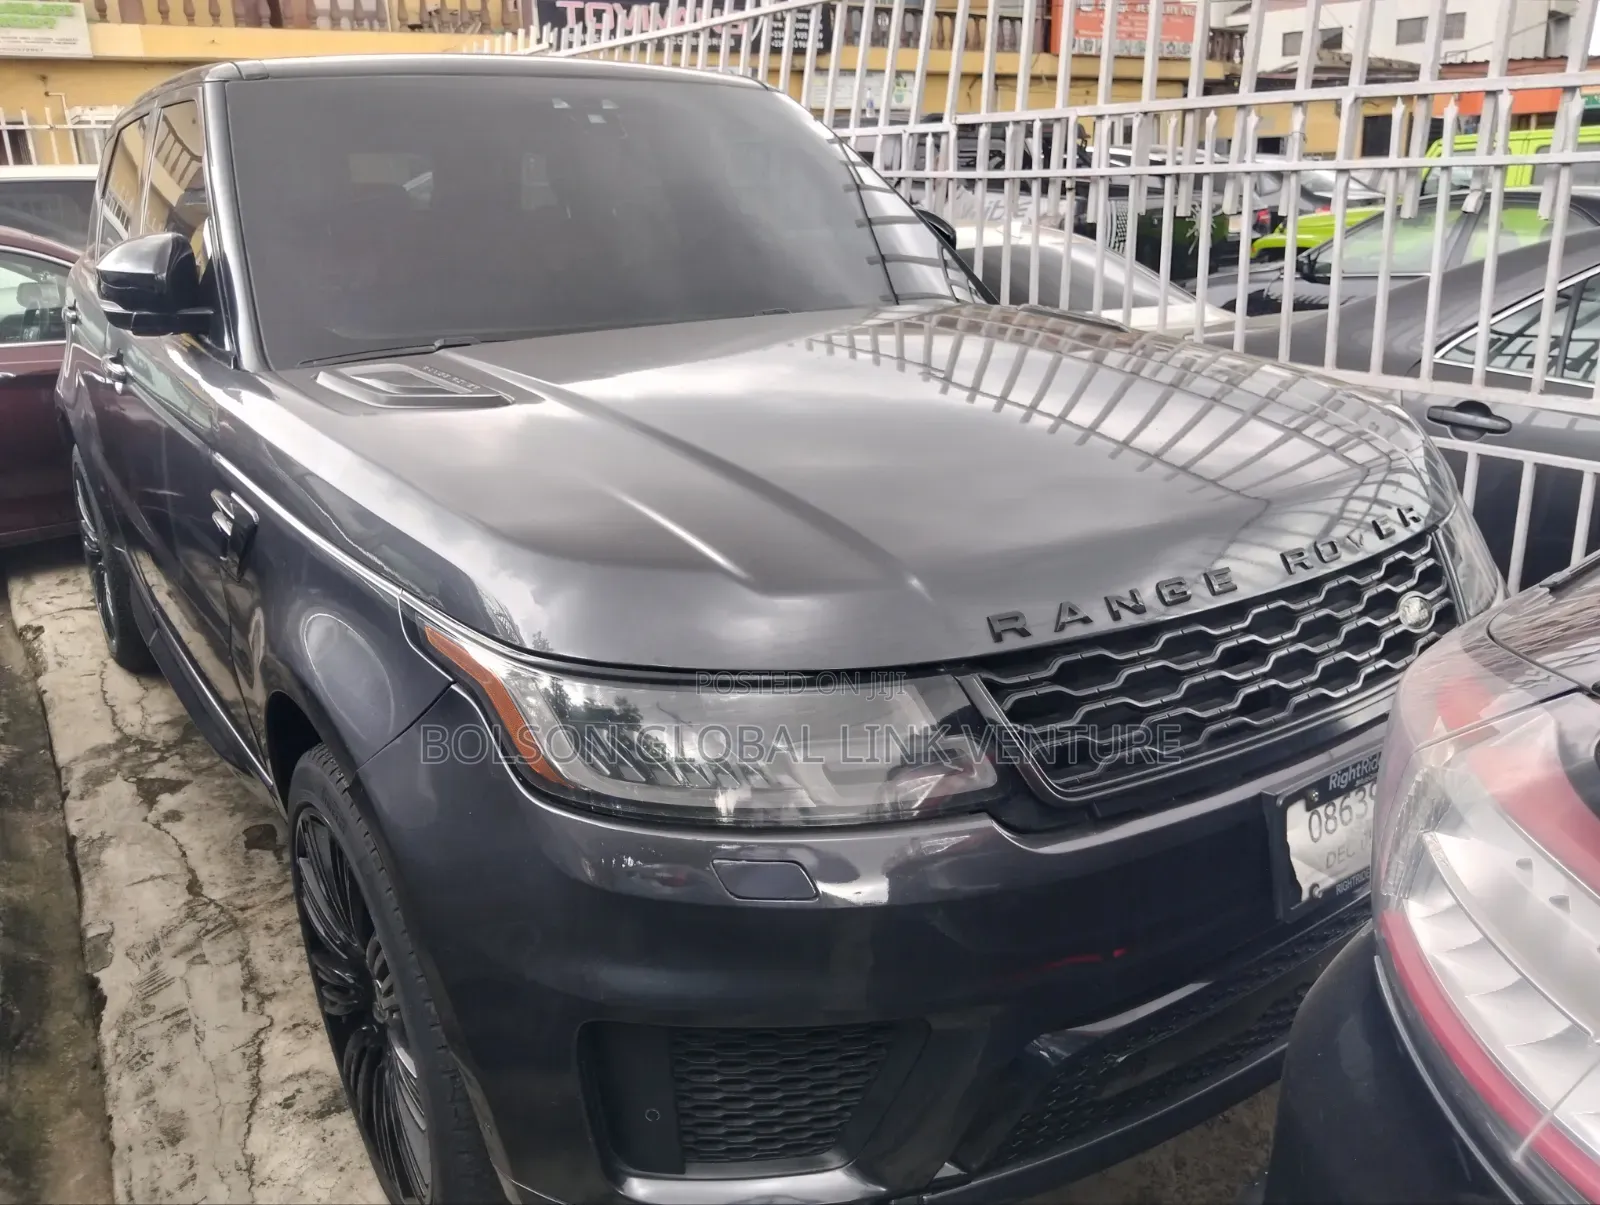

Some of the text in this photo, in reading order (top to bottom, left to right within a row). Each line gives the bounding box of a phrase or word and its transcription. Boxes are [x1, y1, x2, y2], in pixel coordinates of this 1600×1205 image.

[986, 504, 1424, 643] RANGE ROVER
[1329, 754, 1379, 791] RightRid
